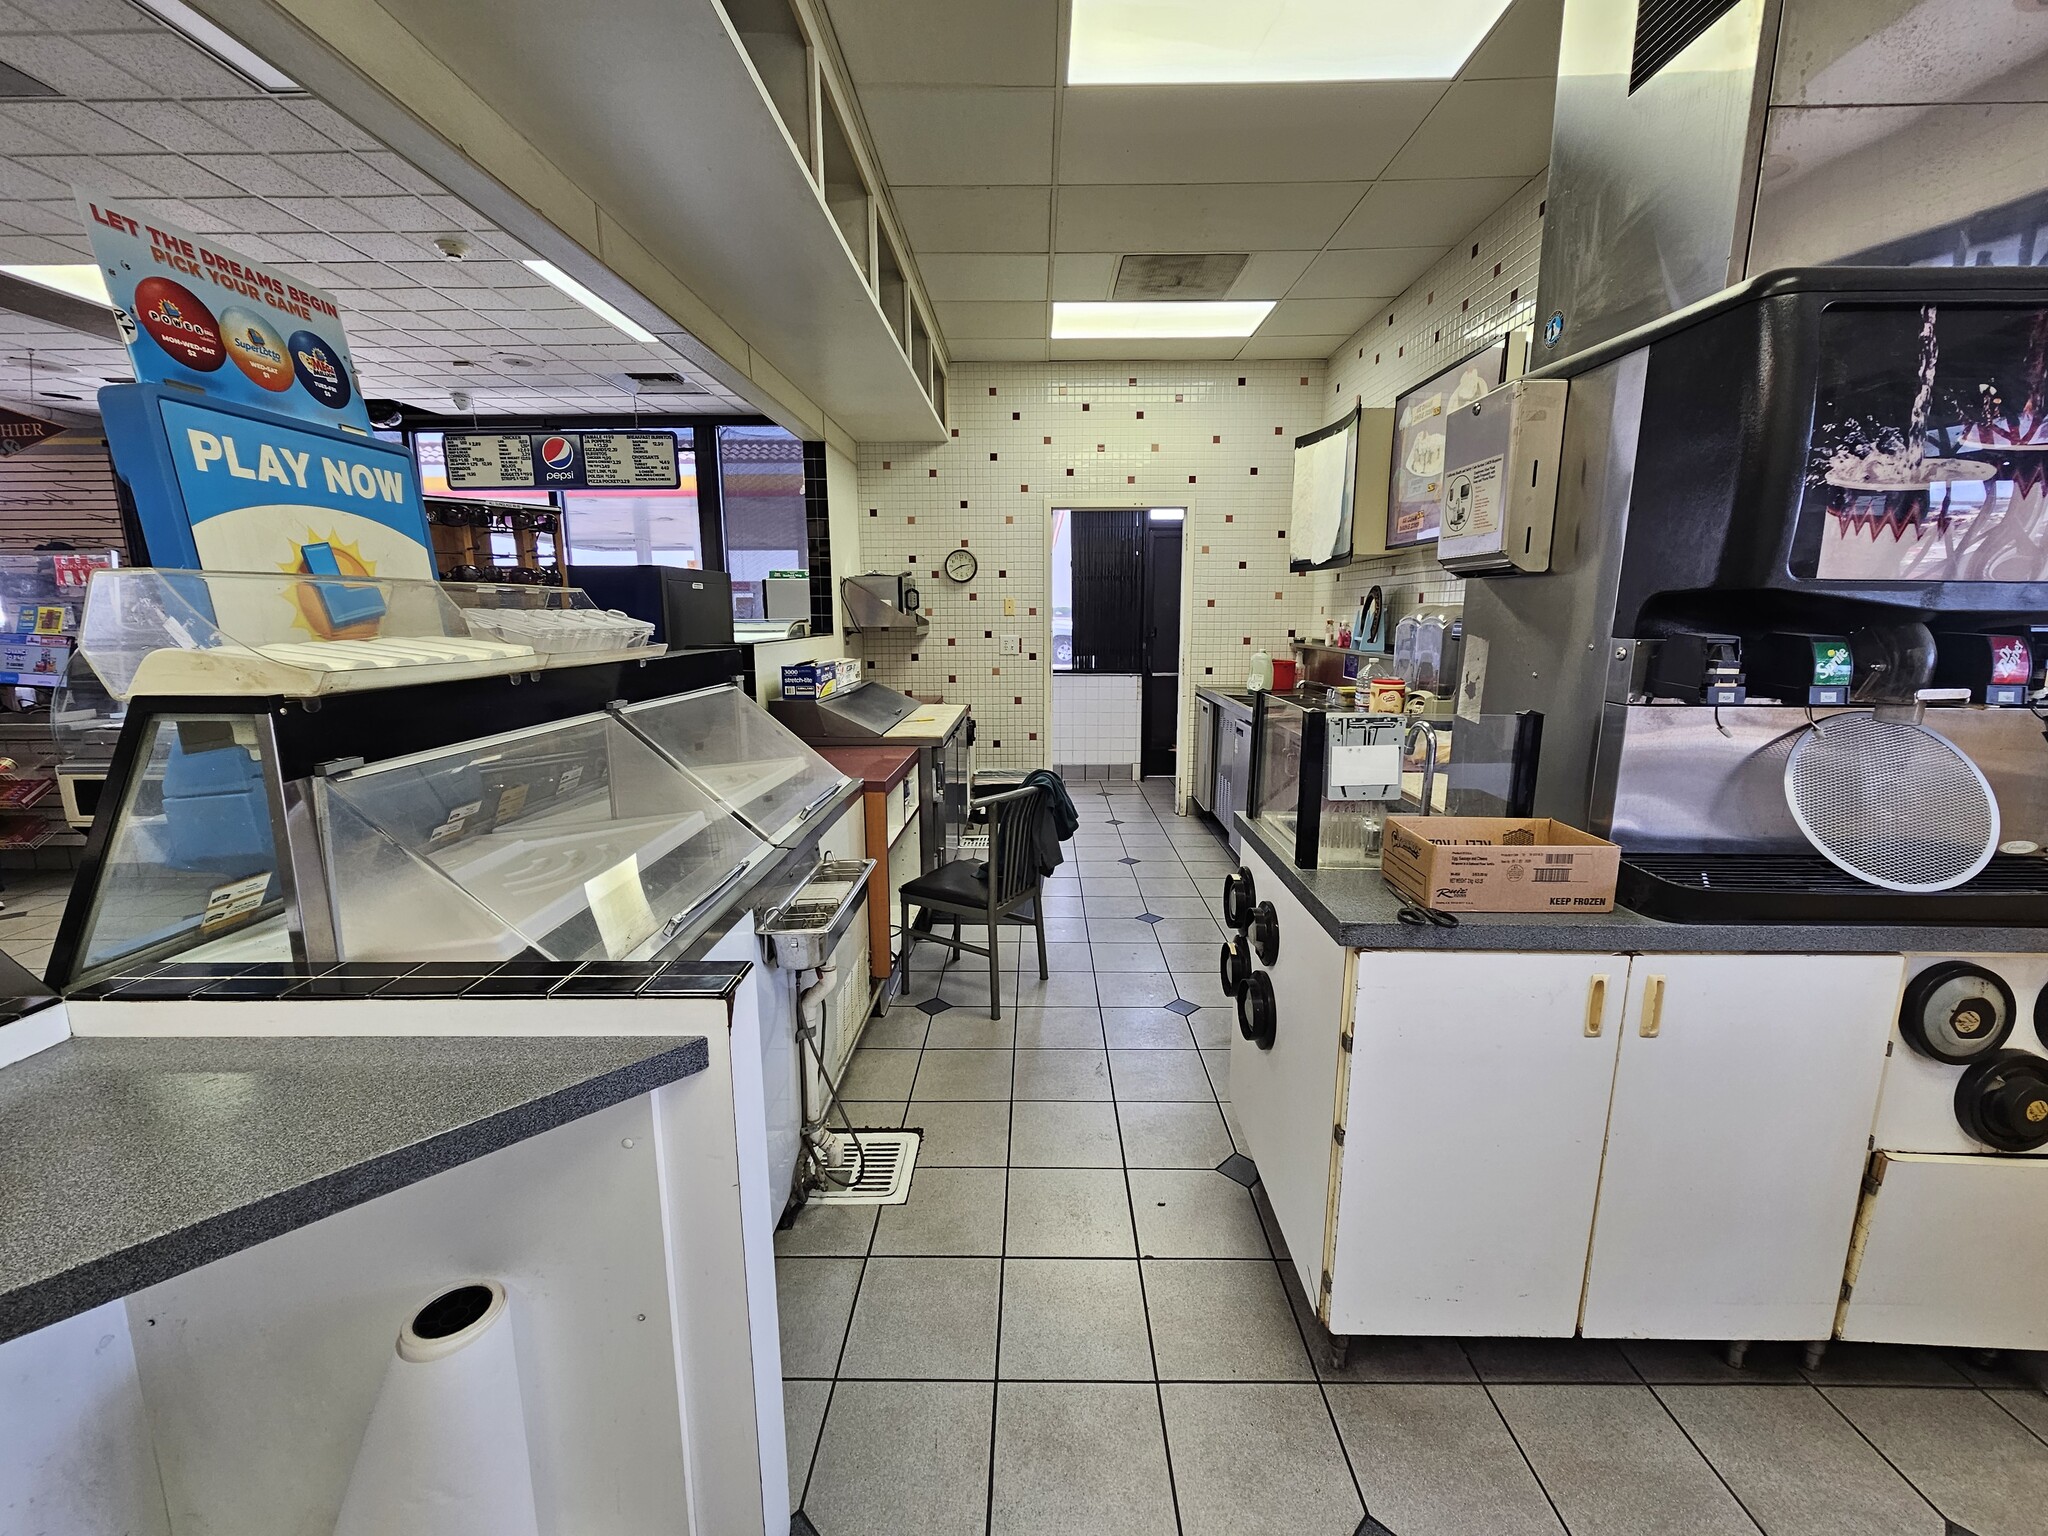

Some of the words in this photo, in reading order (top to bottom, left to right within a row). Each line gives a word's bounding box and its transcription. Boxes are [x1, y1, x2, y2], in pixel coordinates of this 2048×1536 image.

[89, 202, 139, 238] LET
[145, 225, 196, 259] THE
[199, 247, 284, 296] DREAMS
[286, 284, 339, 319] BEGIN
[150, 245, 204, 279] PICK
[205, 266, 262, 302] YOUR
[264, 291, 312, 322] GAME
[161, 334, 216, 356] MON-WED-SAT
[187, 349, 197, 358] $2
[249, 360, 278, 375] WED-SAT
[186, 428, 310, 489] PLAY
[322, 456, 403, 504] NOW
[546, 471, 574, 480] pepsi
[1997, 640, 2023, 678] Pepper
[1999, 645, 2013, 659] Dr
[1815, 648, 1849, 680] Sprite
[1436, 887, 1468, 898] Ruiz
[1550, 897, 1571, 906] KEEP
[1573, 897, 1606, 906] FROZEN
